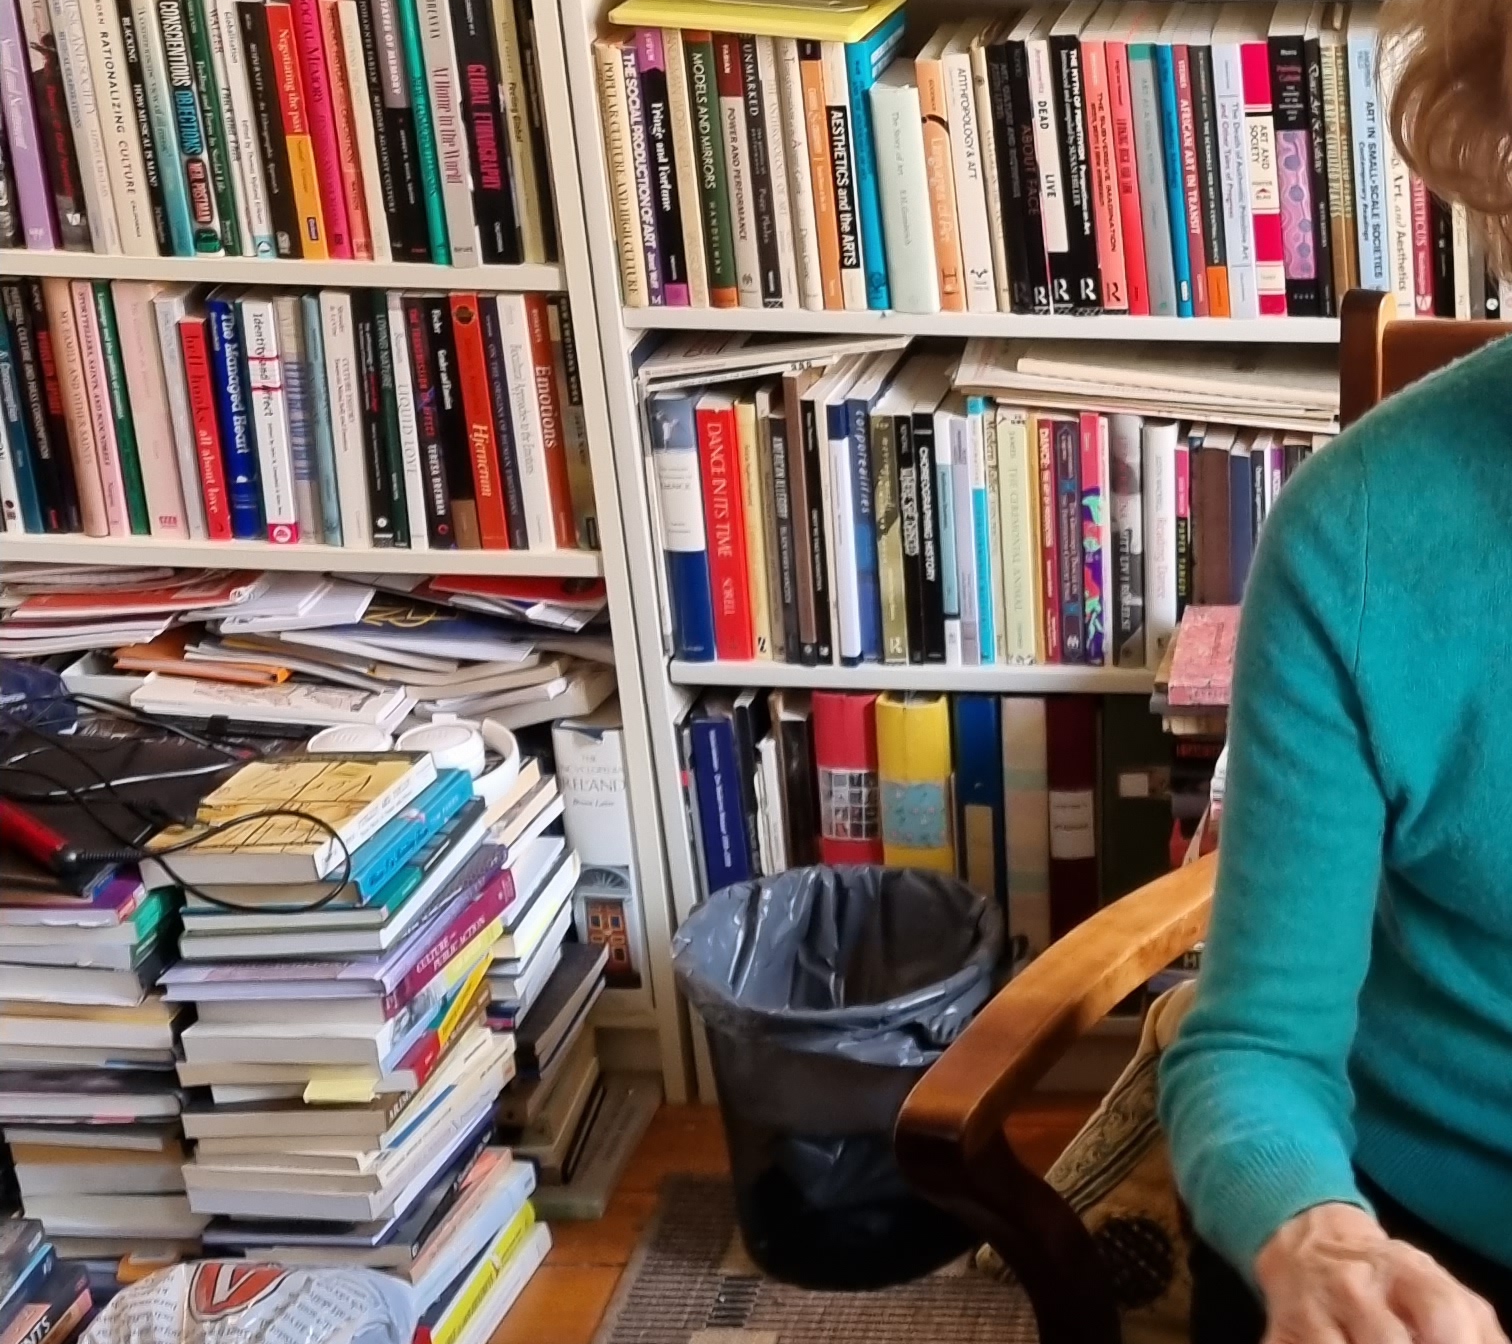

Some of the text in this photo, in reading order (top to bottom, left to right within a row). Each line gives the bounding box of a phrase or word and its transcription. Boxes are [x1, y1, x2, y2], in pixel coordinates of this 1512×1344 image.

[100, 31, 136, 194] RATIONALIZING CULTURE
[158, 1, 211, 222] CONSCIENTIOUS OBJECTIONS NEIL POSTMAN
[467, 64, 500, 190] GLOBAL ETHNOGRAPHY
[622, 54, 657, 248] THE SOCIAL PRODUCTION OF ART
[691, 52, 716, 189] MODELS AND MIRRORS
[1037, 101, 1057, 198] DEAD LIVE
[830, 110, 857, 266] AESTHETICS and the ARTS
[534, 365, 557, 449] Emotions
[707, 422, 732, 558] DANCE IN ITS TIME
[416, 939, 451, 974] CULTURE
